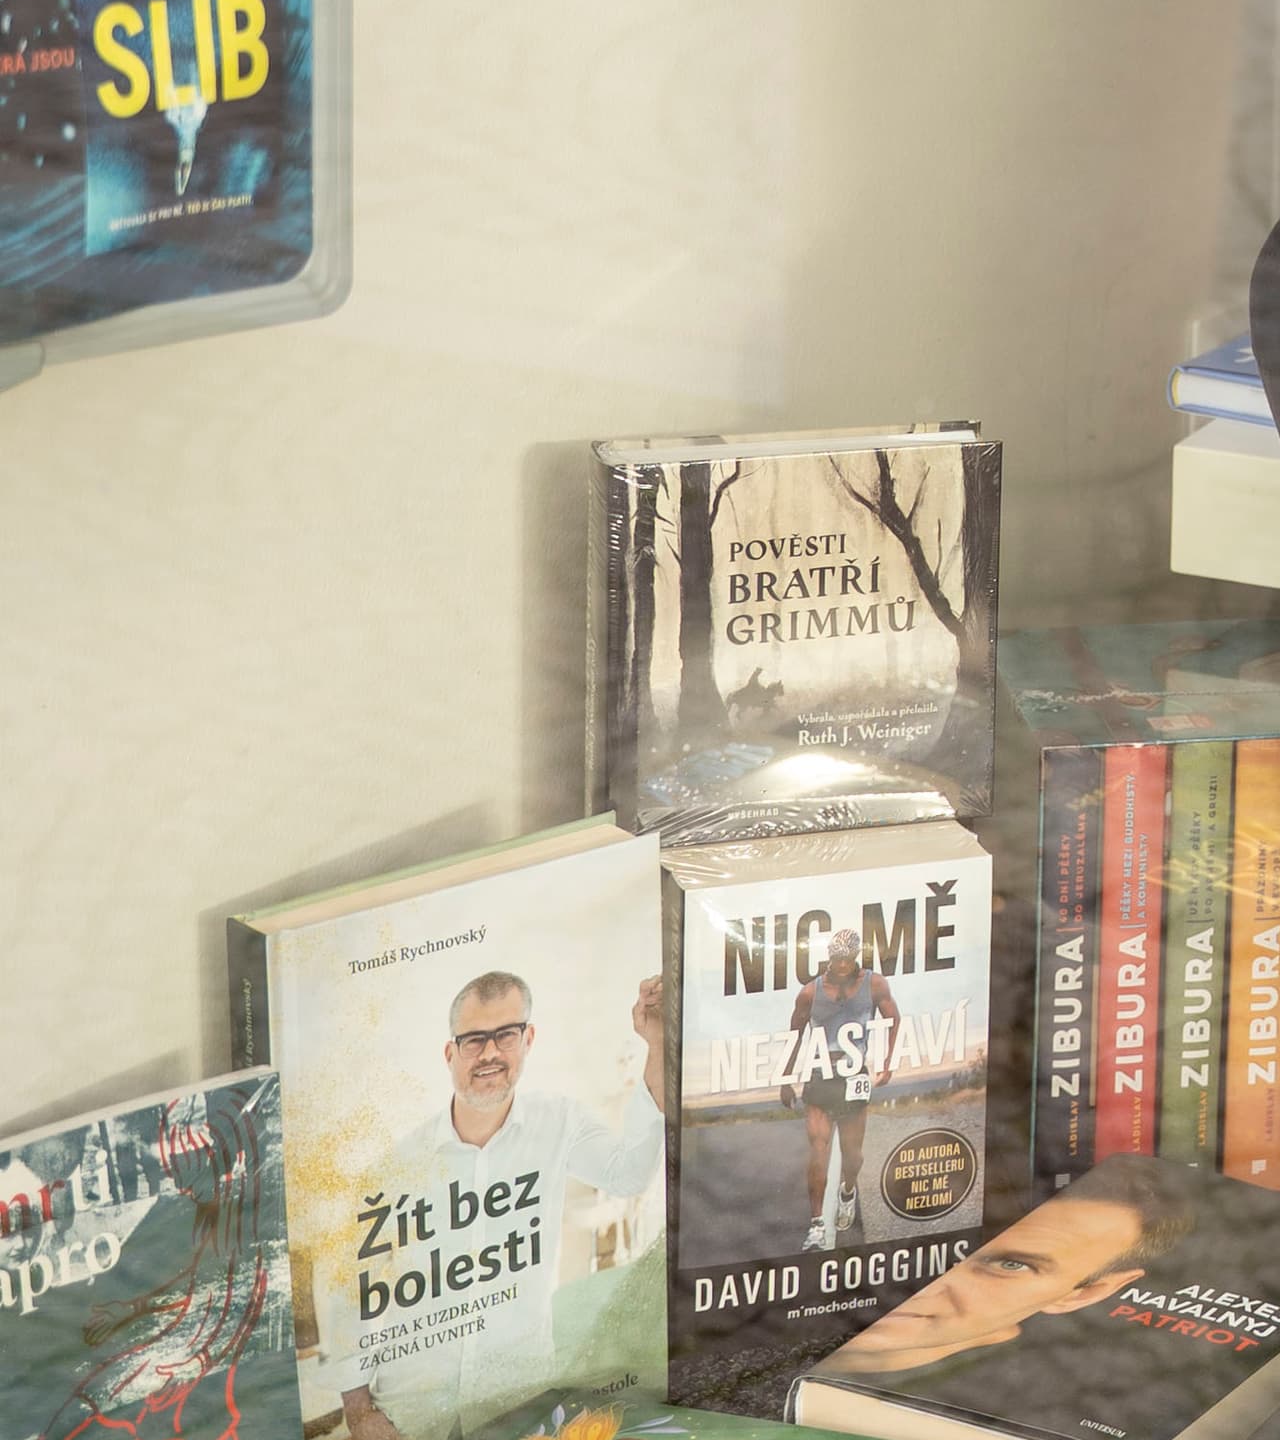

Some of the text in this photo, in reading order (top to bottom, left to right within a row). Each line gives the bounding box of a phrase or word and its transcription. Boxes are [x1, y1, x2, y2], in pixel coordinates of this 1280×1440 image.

[729, 532, 847, 562] POVĚSTI
[728, 556, 881, 605] BRATŘÍ
[726, 596, 917, 646] GRIMMŮ
[798, 721, 931, 746] Ruth Weiniger
[348, 925, 487, 976] Tomáš Rychnovský
[723, 879, 959, 997] NIC MĚ
[1051, 935, 1085, 1098] ZIBURA
[1114, 932, 1148, 1094] ZIBURA
[1181, 927, 1214, 1088] ZIBURA
[710, 997, 972, 1094] NEZASTAVÍ
[894, 1157, 965, 1179] BESTSELLERU
[900, 1142, 961, 1163] OD AUTORA
[911, 1178, 930, 1193] NIC
[357, 1170, 541, 1260] Žít bez
[359, 1216, 542, 1321] bolesti
[695, 1239, 970, 1313] DAVID GOGGINS
[358, 1286, 518, 1350] CESTA UZDRAVENÍ
[1109, 1304, 1261, 1354] PATRIOT
[1119, 1286, 1279, 1339] NAVALNYJ
[359, 1317, 486, 1371] ZAČÍNÁ UVNITŘ
[1079, 1417, 1127, 1439] UNIVERSUM
